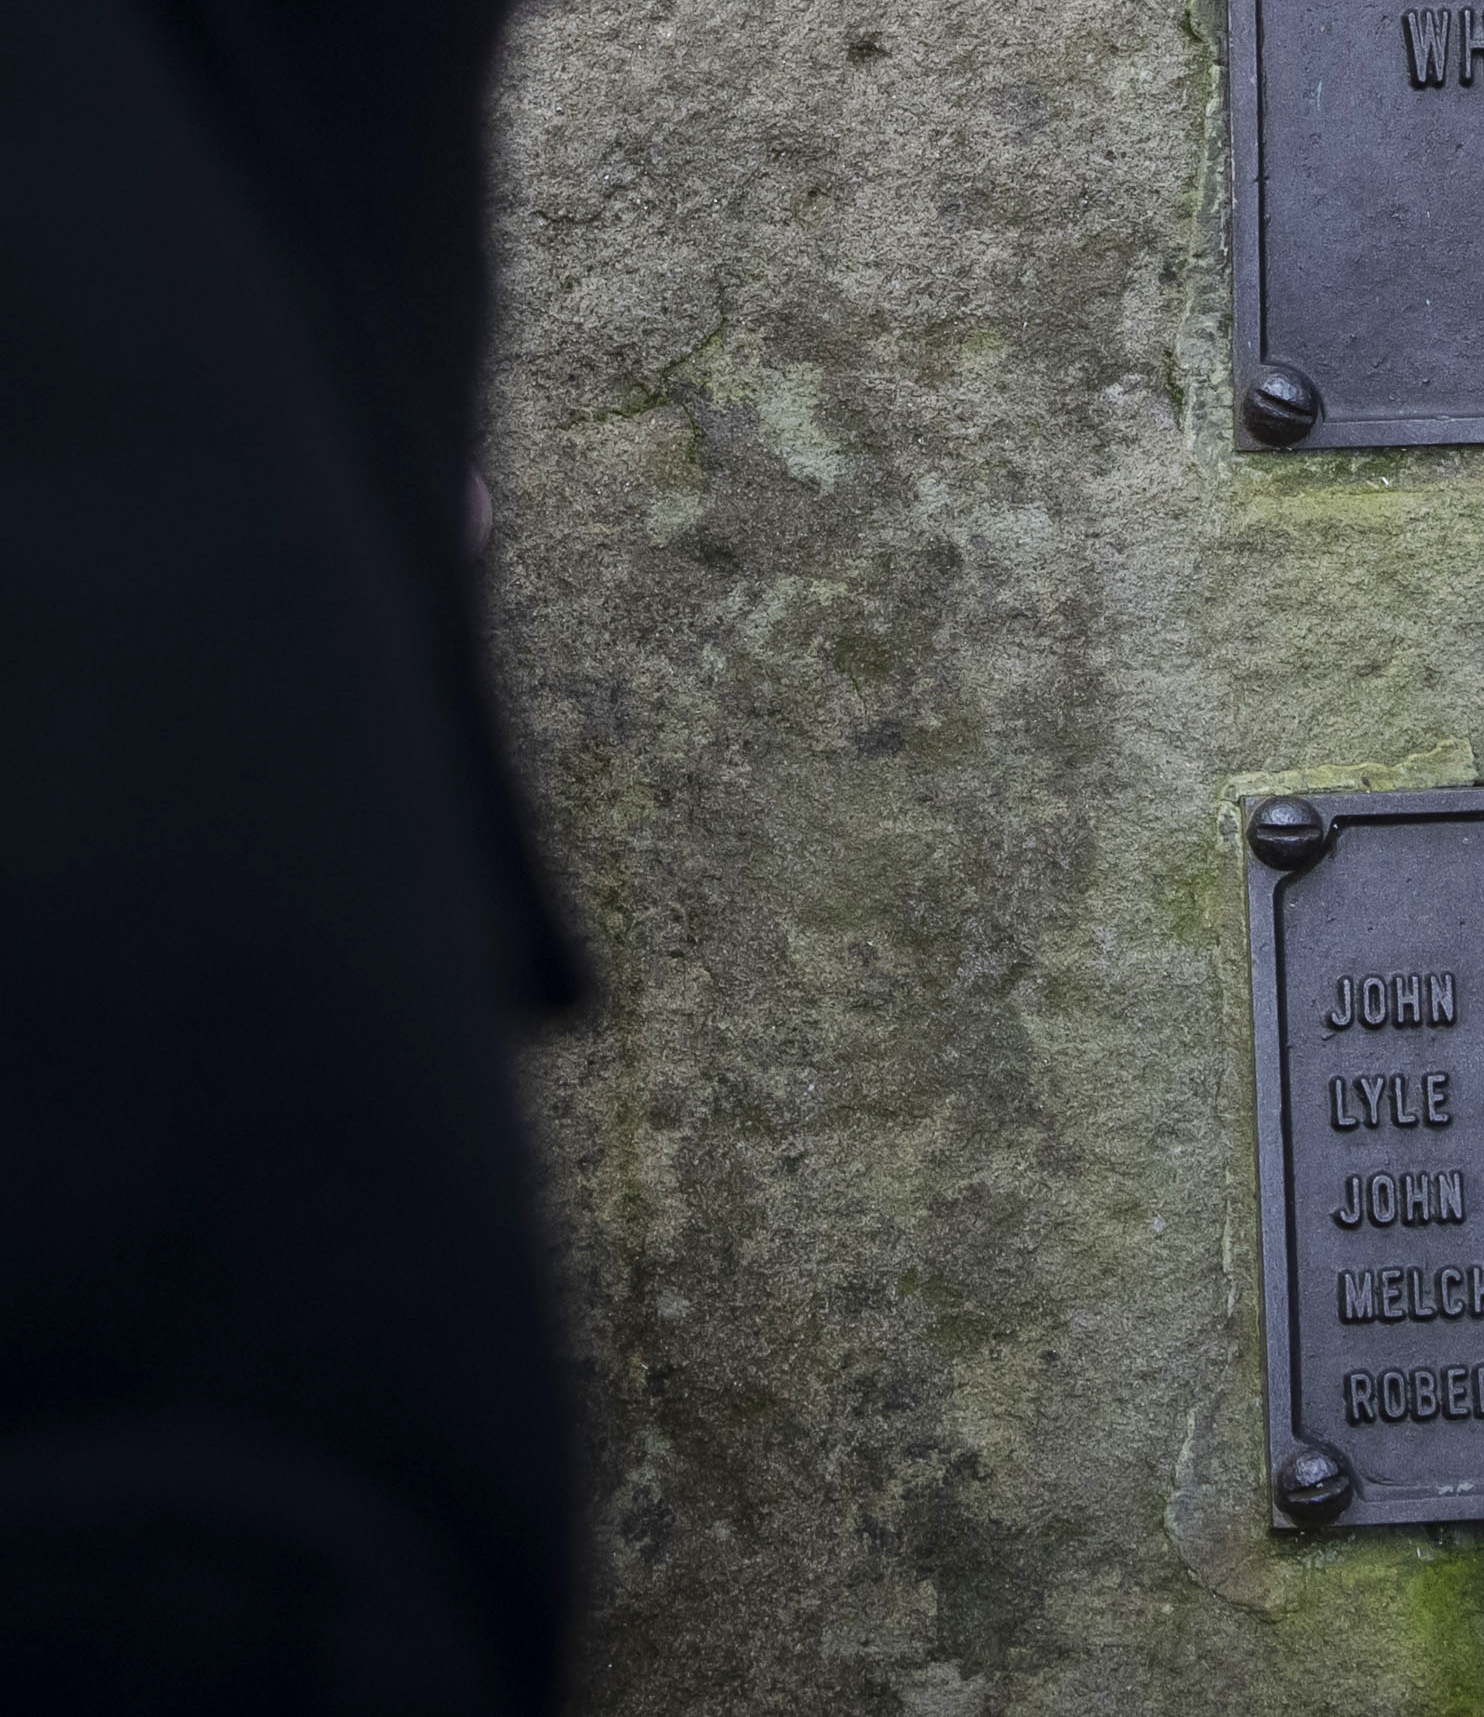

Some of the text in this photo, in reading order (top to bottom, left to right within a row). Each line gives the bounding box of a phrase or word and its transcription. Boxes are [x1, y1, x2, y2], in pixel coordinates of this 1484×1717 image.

[1326, 974, 1456, 1029] JOHN
[1331, 1074, 1450, 1130] LYLE
[1335, 1173, 1463, 1228] JOHN
